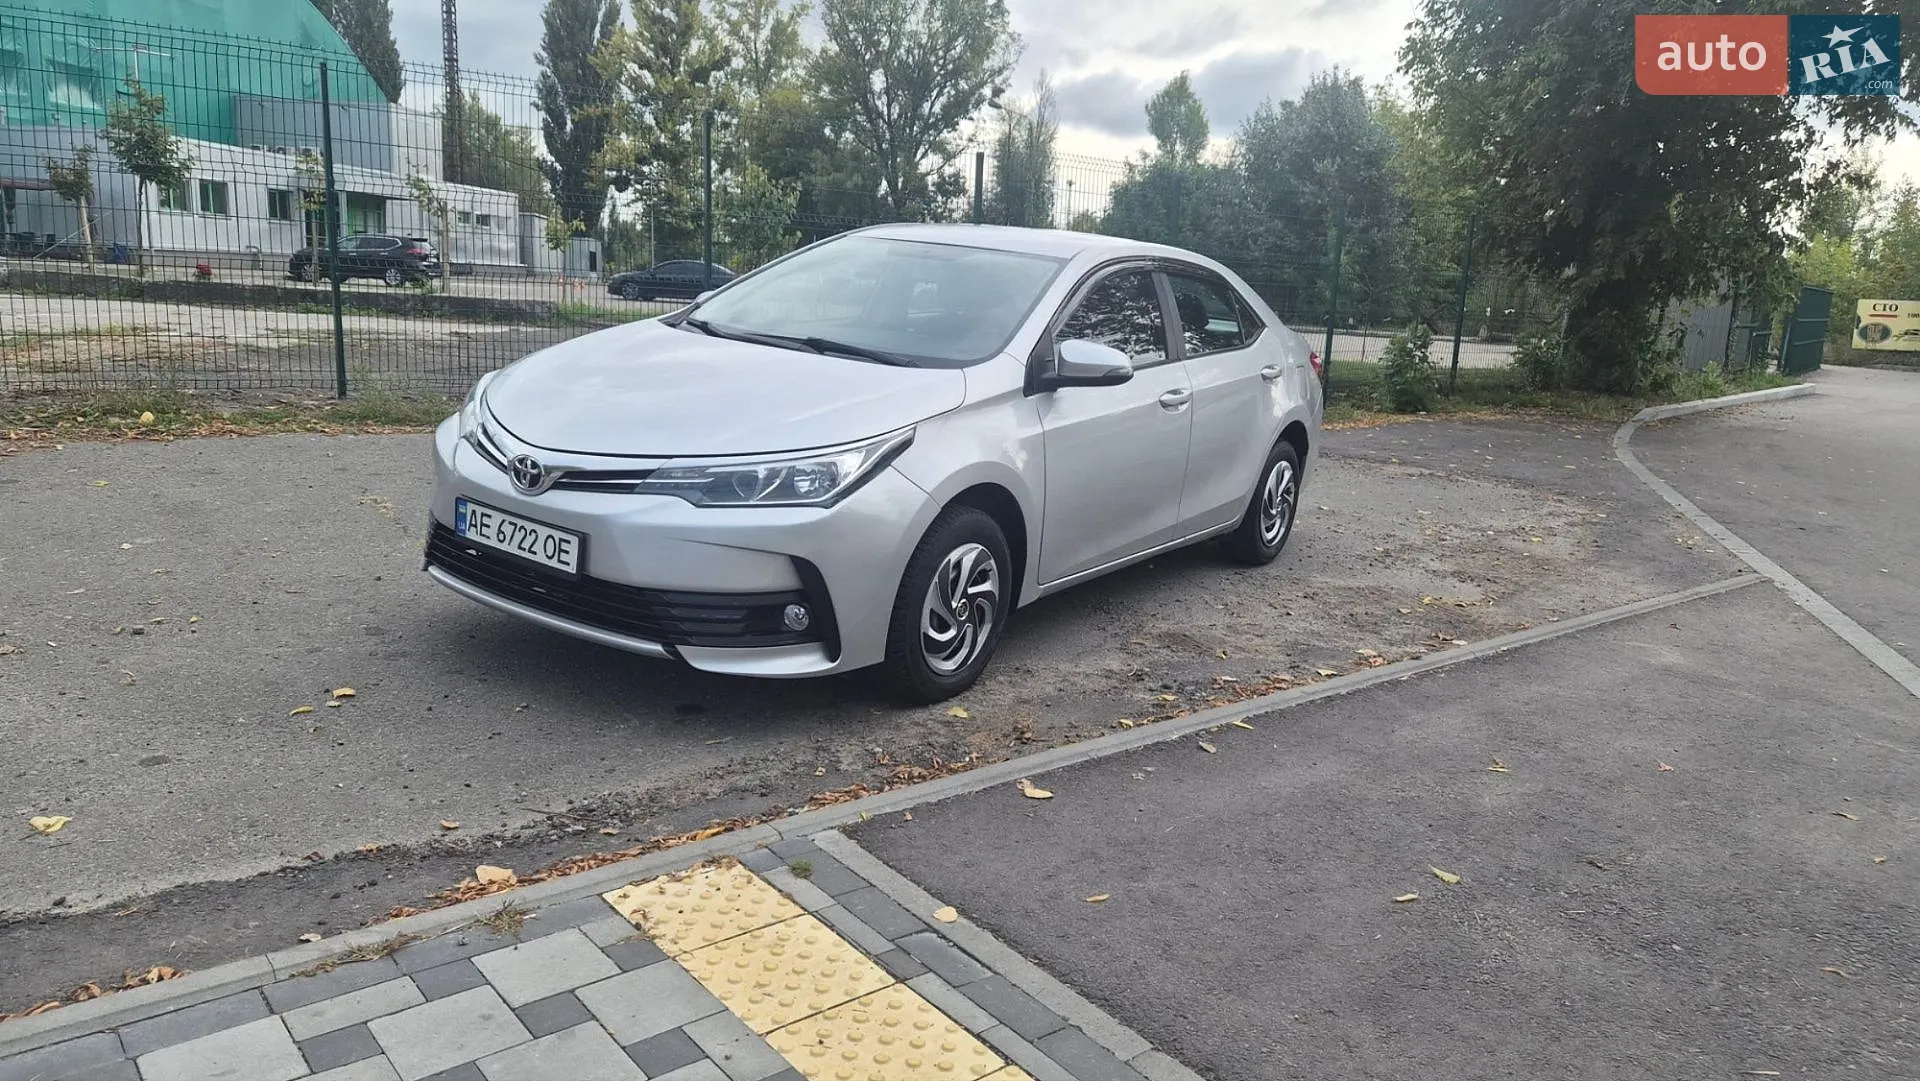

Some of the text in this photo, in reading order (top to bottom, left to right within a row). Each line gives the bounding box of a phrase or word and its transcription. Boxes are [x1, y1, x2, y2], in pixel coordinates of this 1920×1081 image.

[467, 509, 571, 567] AE 6722 OE
